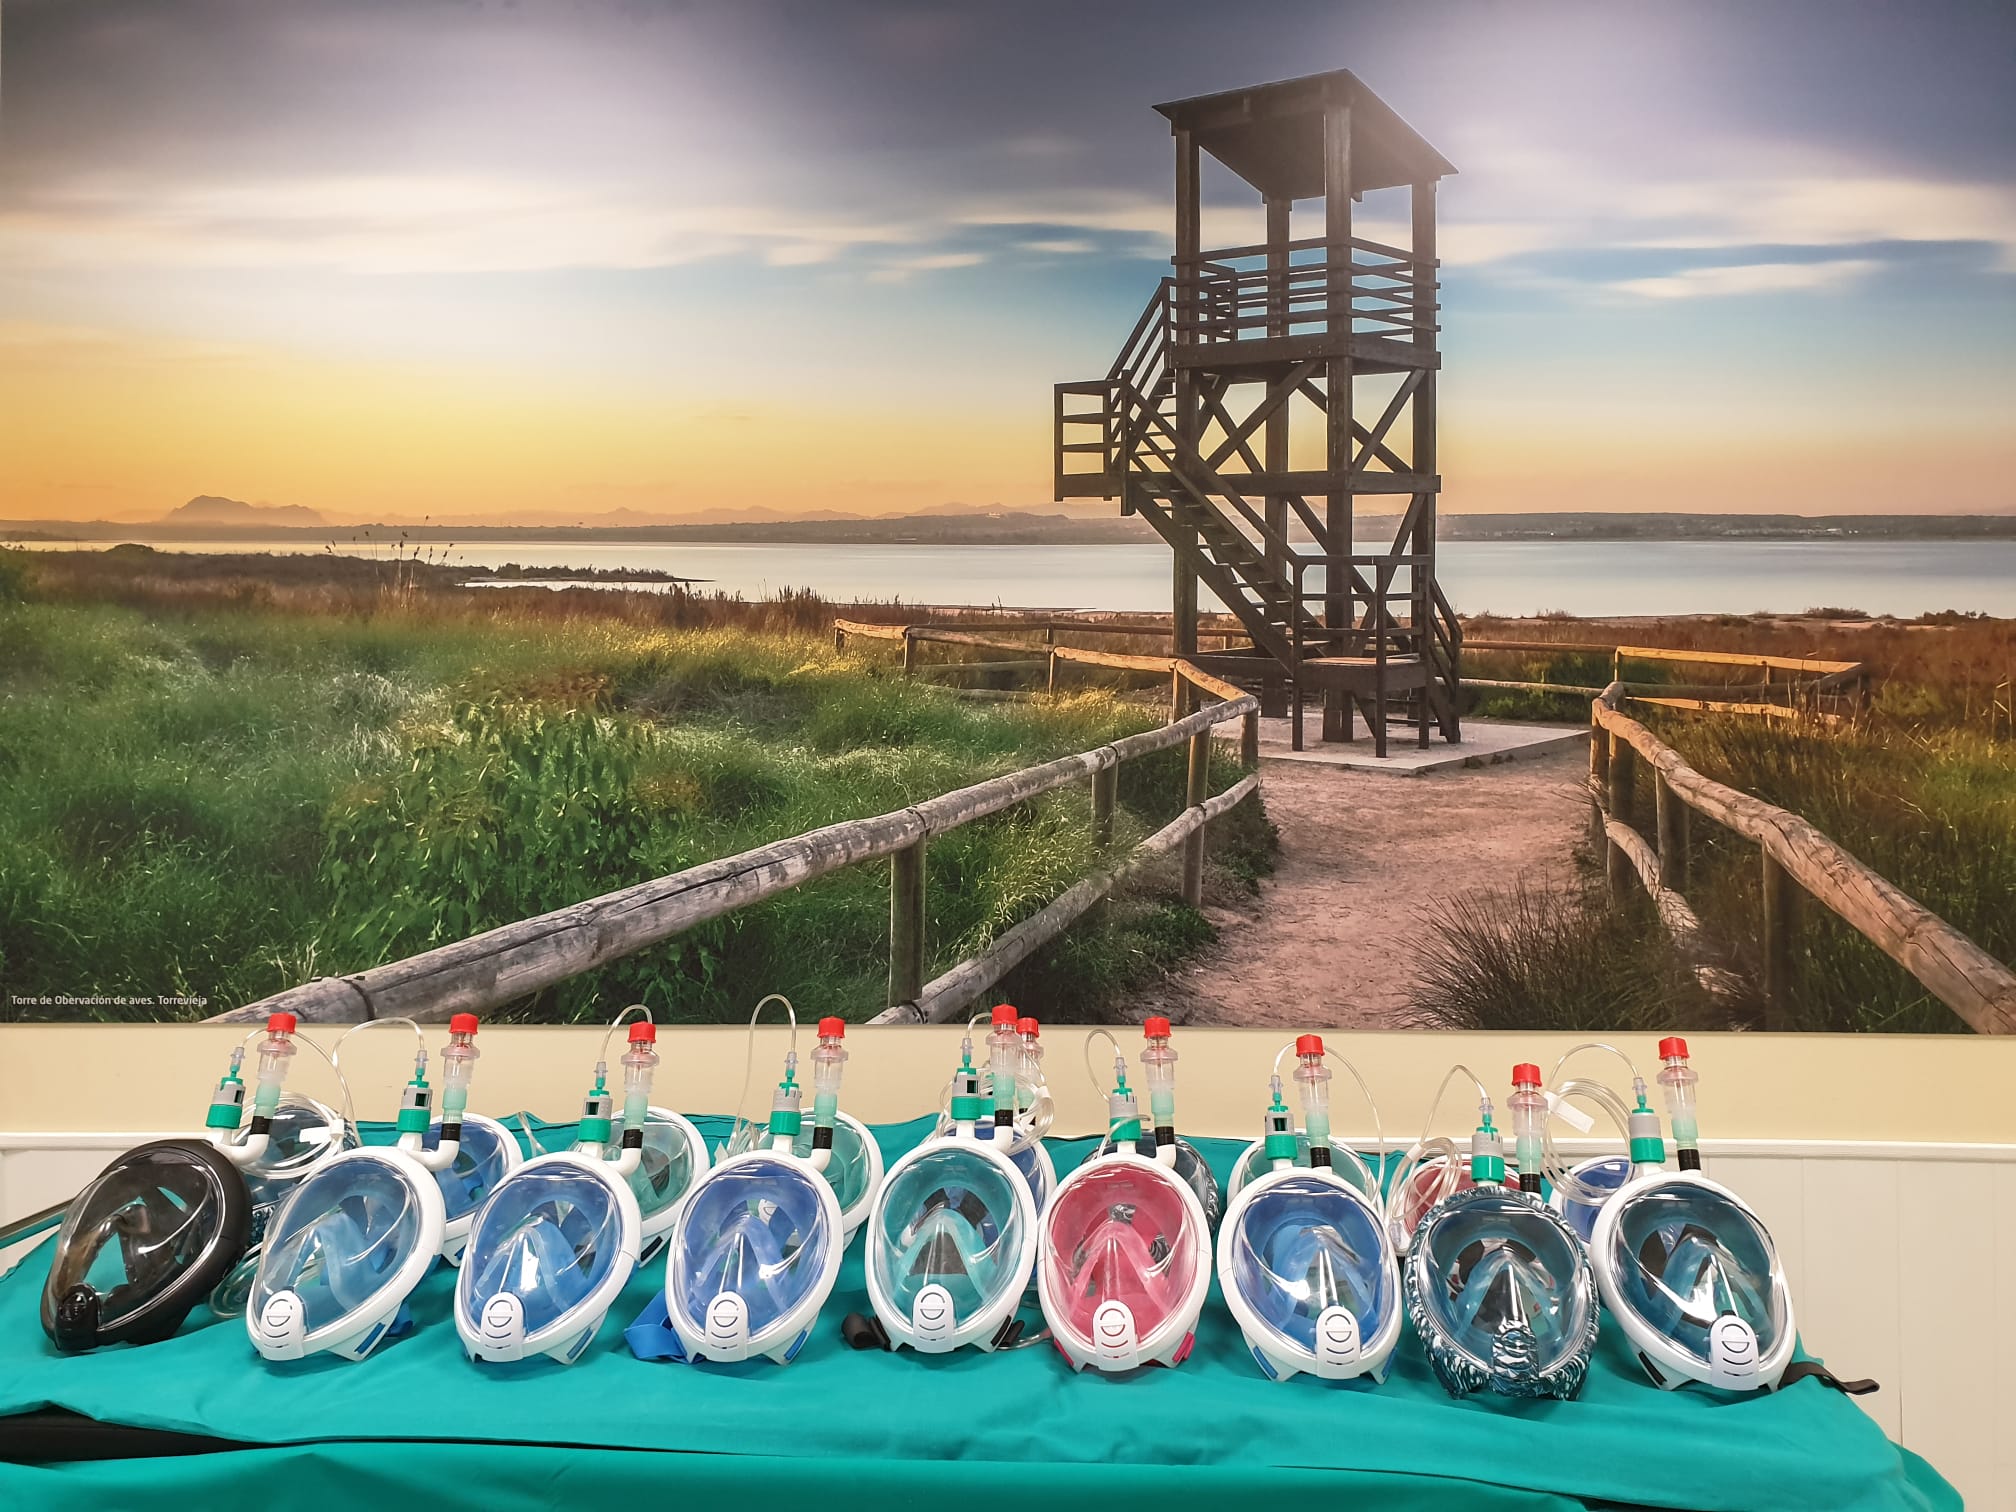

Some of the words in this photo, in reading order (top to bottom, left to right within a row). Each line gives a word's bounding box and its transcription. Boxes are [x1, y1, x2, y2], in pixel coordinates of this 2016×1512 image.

[11, 995, 37, 1005] Torre
[39, 995, 52, 1005] de
[55, 995, 111, 1005] Obervación
[113, 995, 127, 1005] de
[129, 997, 155, 1005] aves.
[157, 995, 208, 1007] Torrevieja
